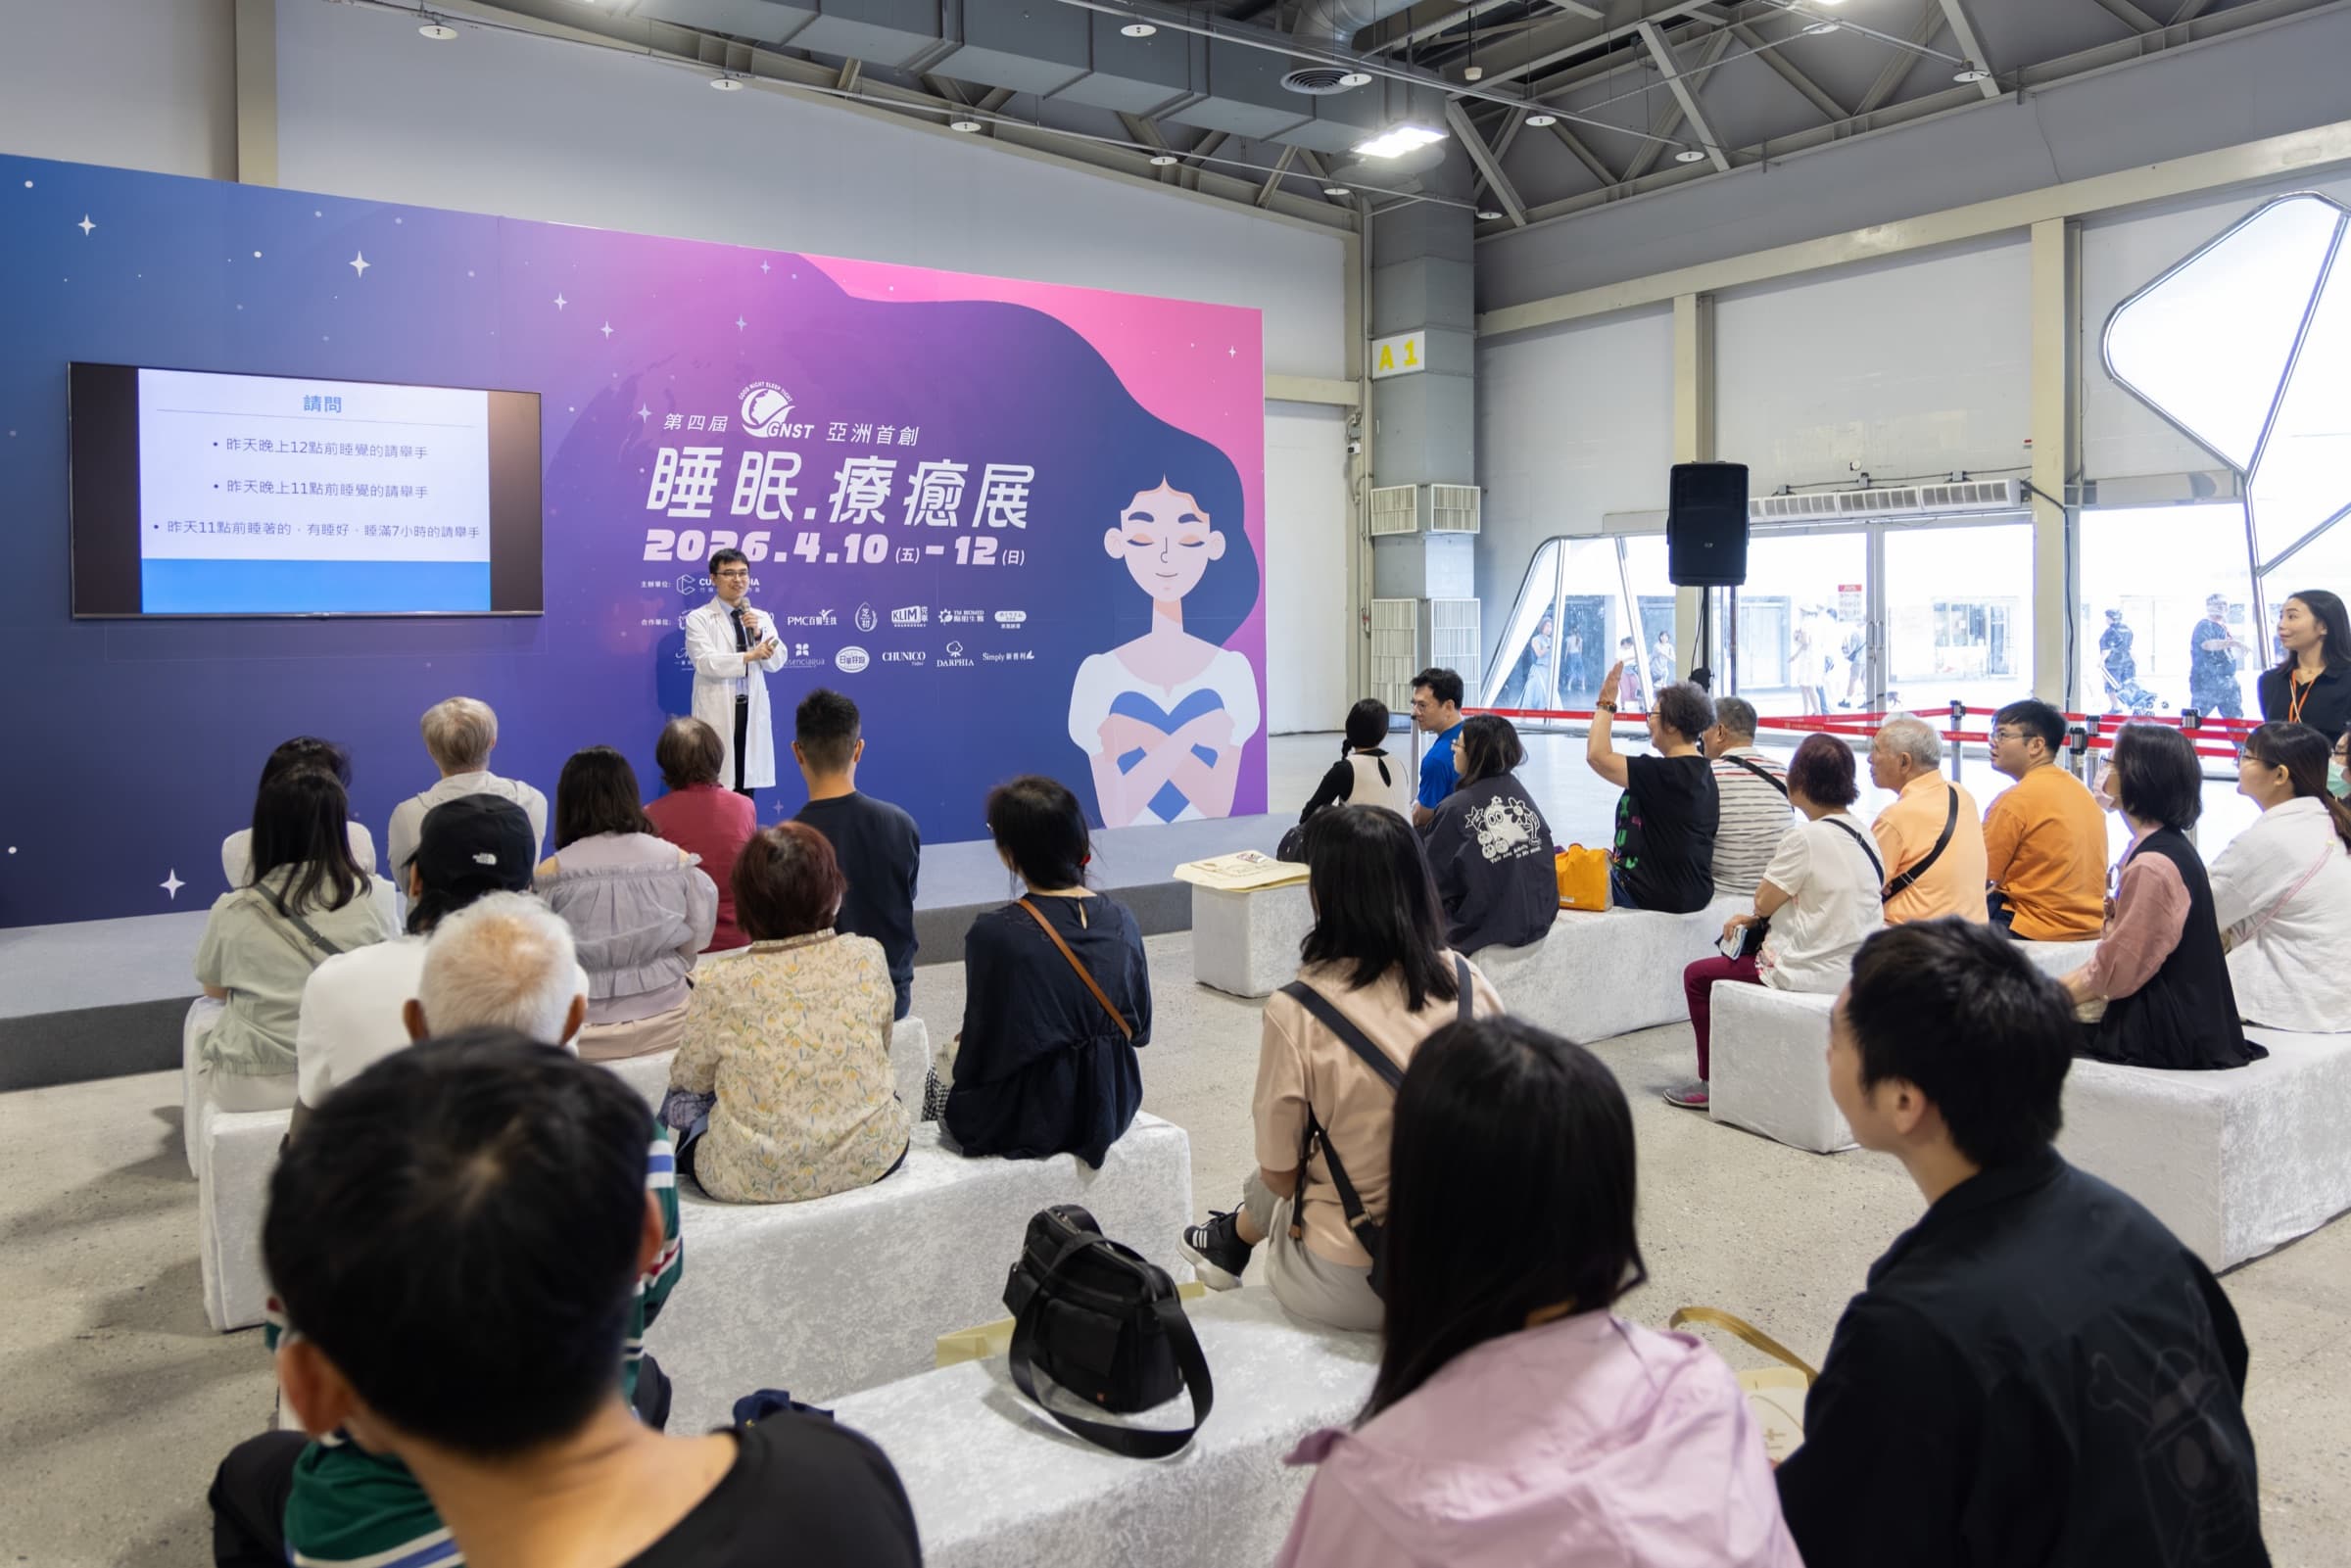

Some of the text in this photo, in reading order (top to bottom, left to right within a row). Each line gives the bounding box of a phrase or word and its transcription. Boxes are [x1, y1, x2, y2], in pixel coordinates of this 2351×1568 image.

[303, 395, 342, 413] 請問
[663, 412, 729, 433] 第四屆
[767, 422, 815, 440] GNST
[826, 421, 920, 447] 亞洲首創
[954, 536, 998, 565] 12
[892, 607, 918, 622] KLIM
[882, 651, 926, 662] CHUNICO
[936, 658, 975, 667] DARPHIA
[983, 651, 1004, 662] Simply
